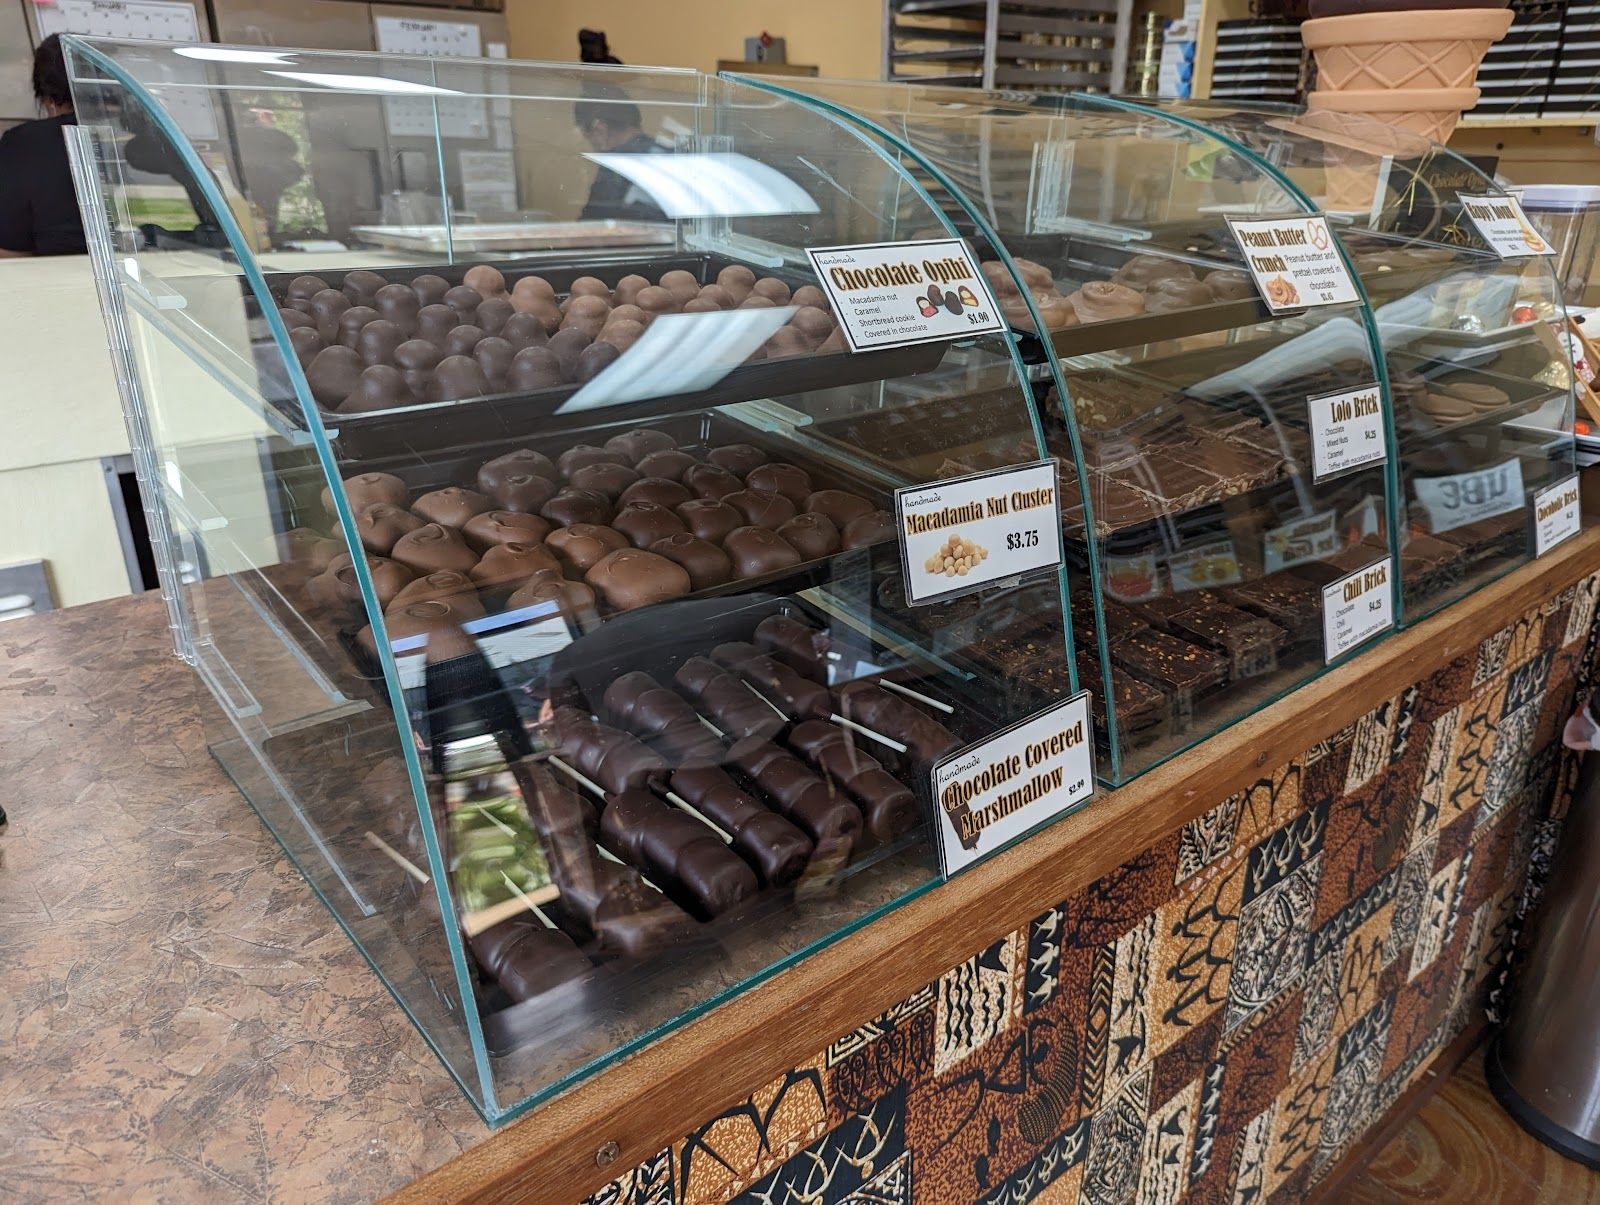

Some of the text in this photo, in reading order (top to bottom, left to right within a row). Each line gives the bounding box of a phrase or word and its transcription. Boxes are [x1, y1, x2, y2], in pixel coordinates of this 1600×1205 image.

[1237, 227, 1307, 247] Peanut Butter
[817, 254, 856, 265] handmade
[1251, 254, 1288, 273] Crunch
[1284, 255, 1305, 264] Peanut
[829, 257, 973, 292] Chocolate Opihi
[848, 293, 898, 304] Macadamia nut
[854, 306, 882, 315] Caramel
[967, 311, 990, 325] $1.90
[858, 314, 916, 327] Shortbread cookie
[864, 324, 928, 338] Covered in chocolate
[1331, 393, 1379, 423] Lolo Brick
[905, 492, 942, 508] handmade
[906, 487, 1054, 536] Macadamia Nut Cluster
[1006, 530, 1039, 551] $3.75
[1343, 576, 1362, 603] Chili
[1364, 565, 1387, 593] Brick
[938, 755, 981, 784] handmade
[941, 720, 1084, 812] Chocolate Covered
[960, 766, 1063, 840] Marshmallow
